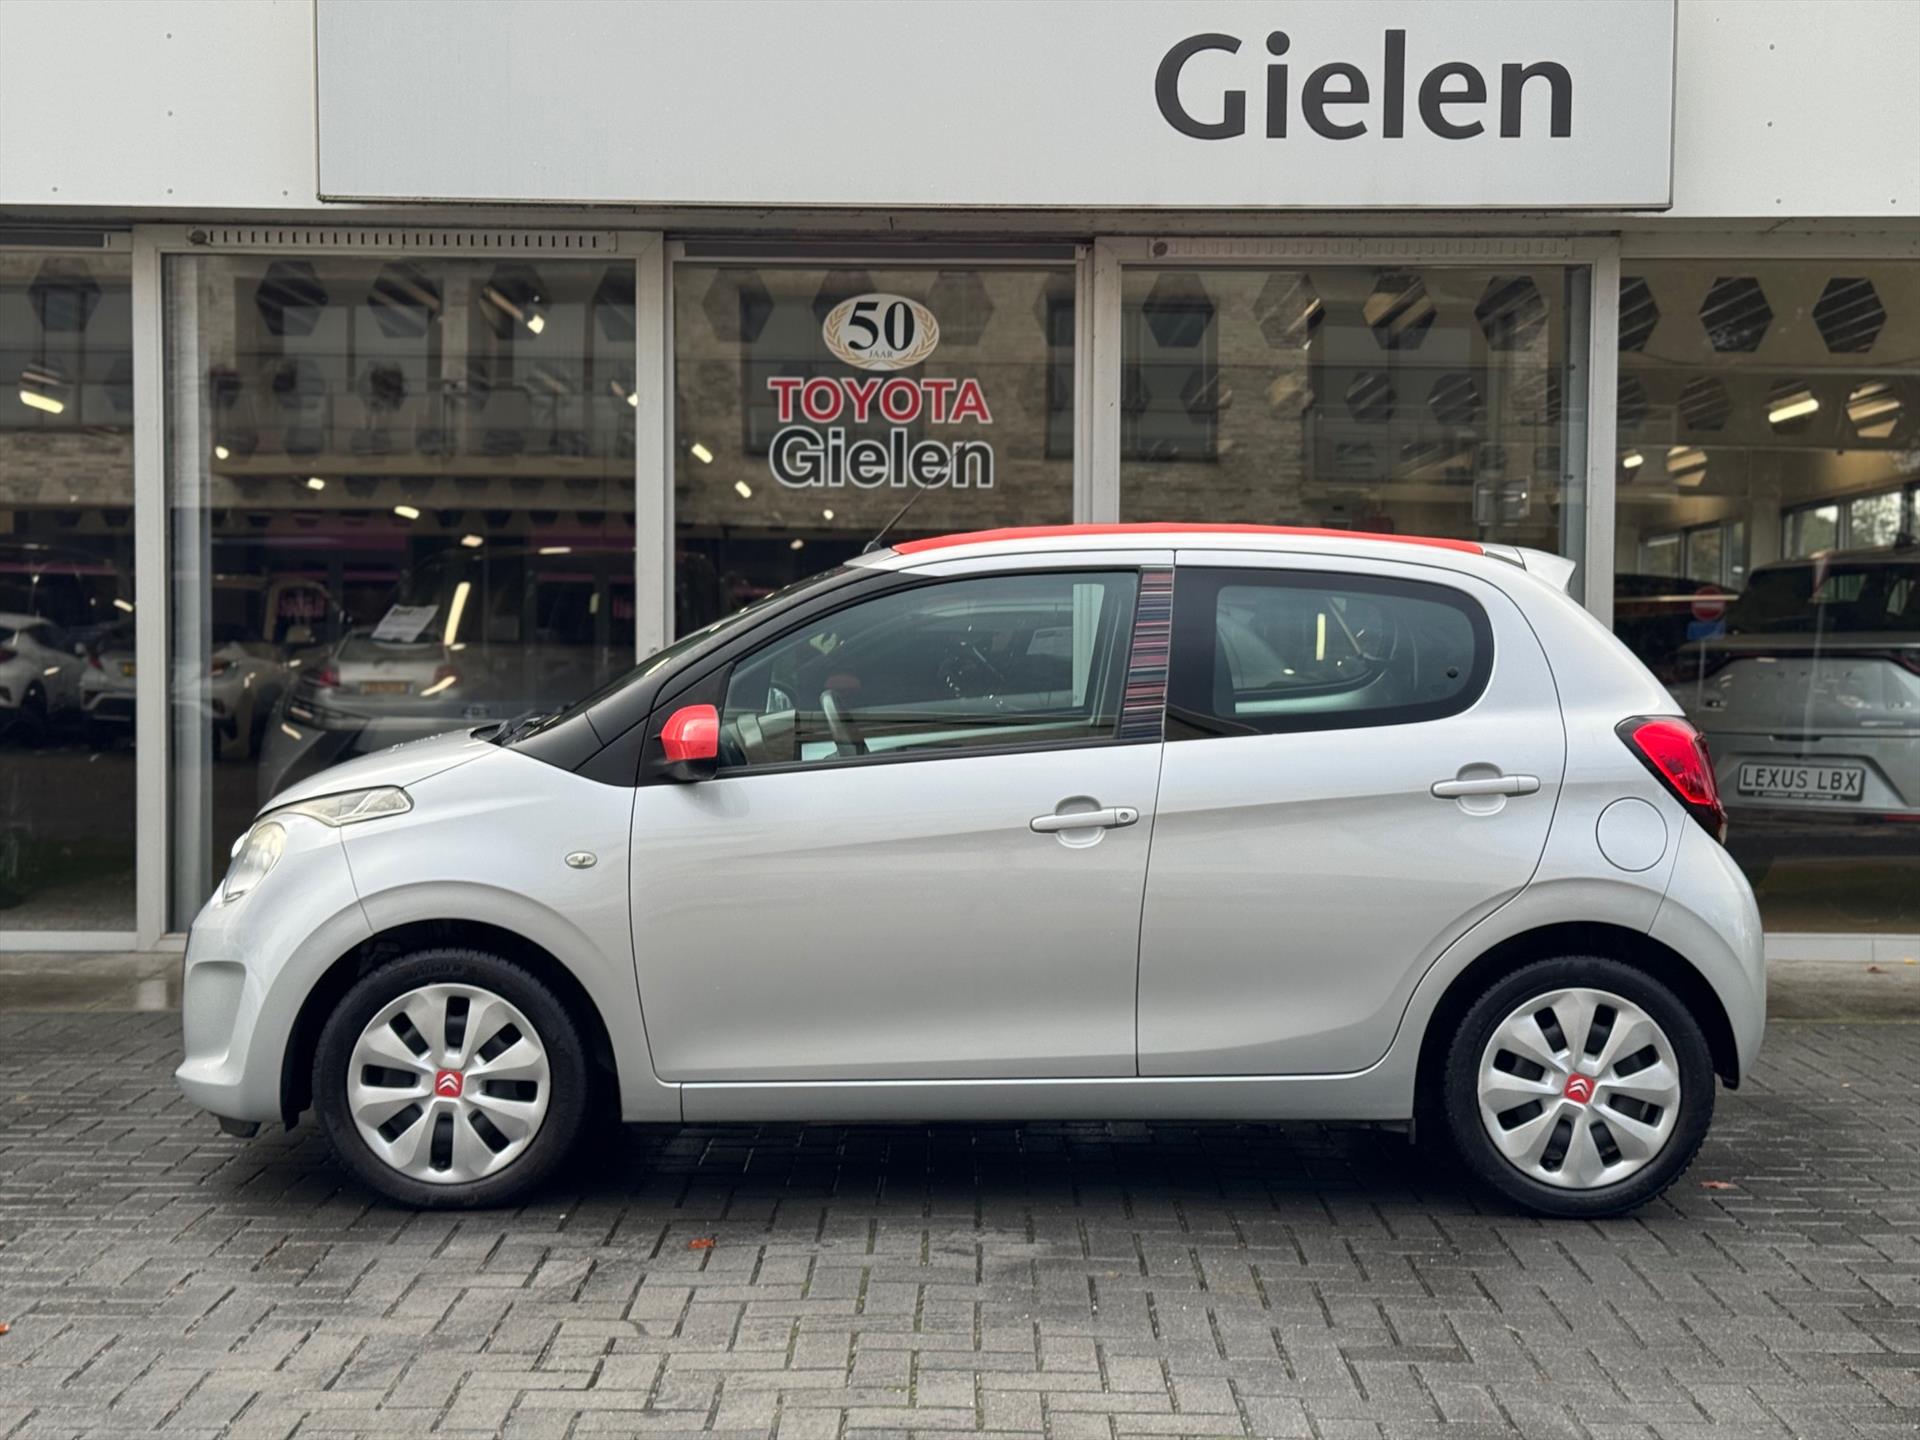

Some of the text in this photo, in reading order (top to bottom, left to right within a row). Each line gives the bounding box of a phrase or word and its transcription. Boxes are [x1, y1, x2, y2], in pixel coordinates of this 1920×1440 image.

[1155, 29, 1573, 140] Gielen
[848, 302, 914, 350] 50
[868, 350, 894, 360] JAAR
[768, 377, 993, 424] TOYOTA
[769, 425, 994, 488] Gielen
[1742, 767, 1857, 792] LEXUS LBX
